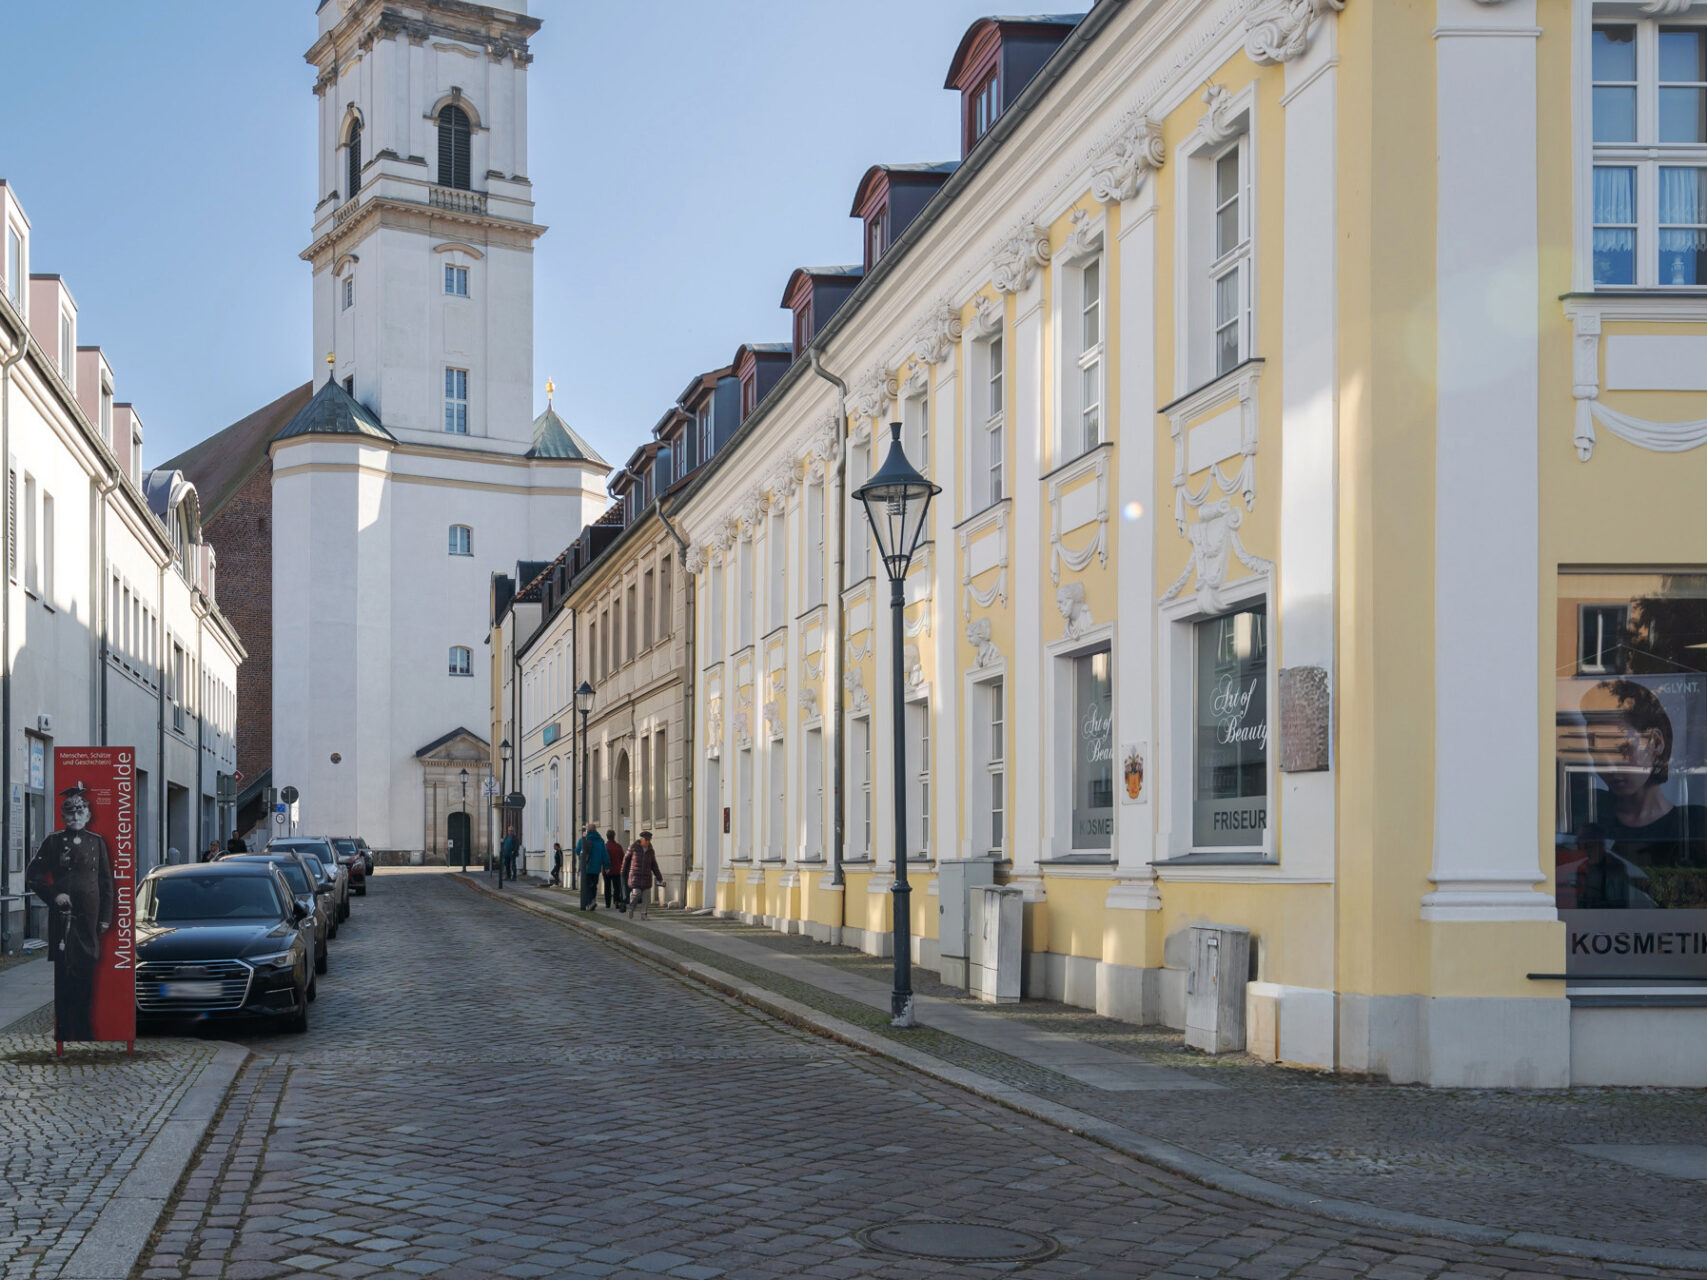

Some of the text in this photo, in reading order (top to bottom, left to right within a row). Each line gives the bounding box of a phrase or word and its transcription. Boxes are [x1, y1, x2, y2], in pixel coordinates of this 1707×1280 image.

[1210, 674, 1257, 719] Art of
[1217, 715, 1267, 751] Beauty
[1213, 809, 1267, 830] FRISEUR
[112, 752, 132, 969] Museum Fürstenwalde
